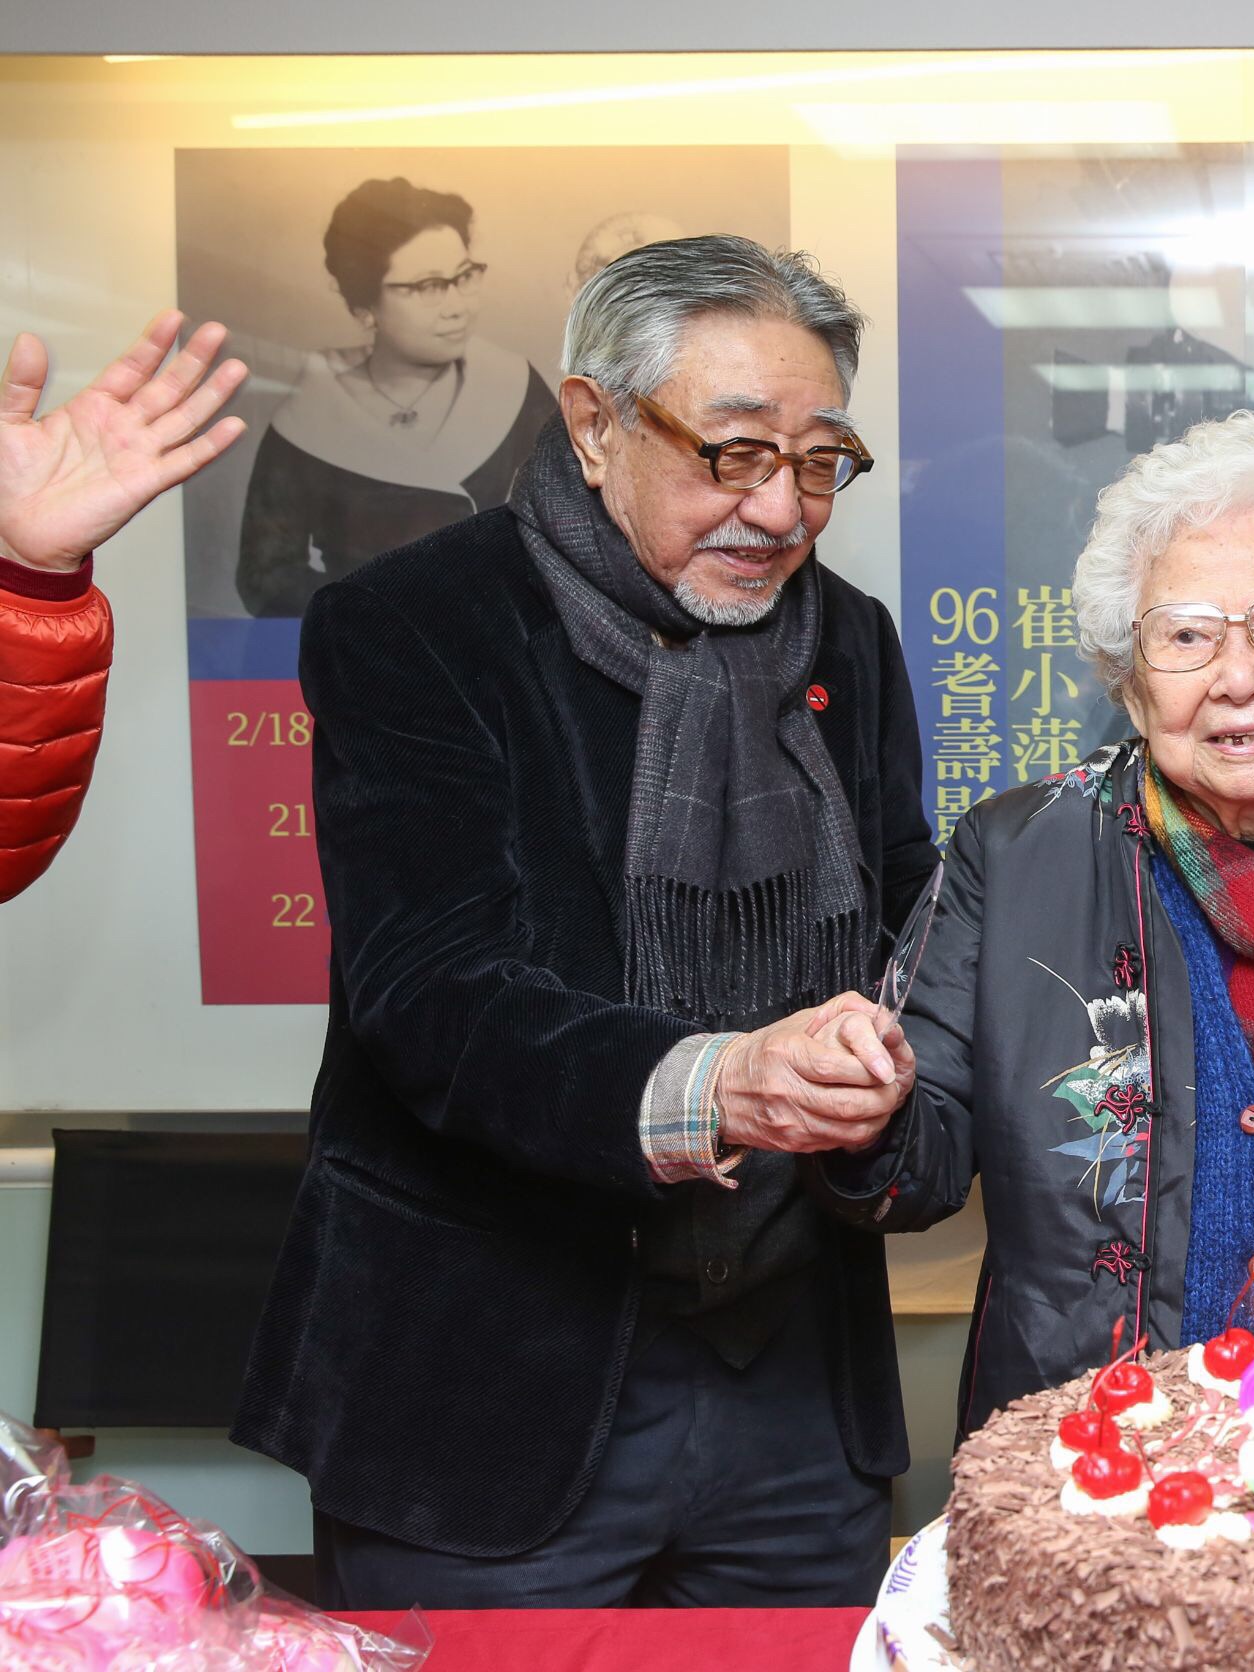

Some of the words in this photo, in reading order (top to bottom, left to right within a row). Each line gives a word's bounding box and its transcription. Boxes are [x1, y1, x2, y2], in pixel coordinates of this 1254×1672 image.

[1011, 585, 1082, 782] 崔小萍
[227, 712, 311, 746] 2/18
[268, 803, 311, 837] 21
[271, 893, 315, 927] 22
